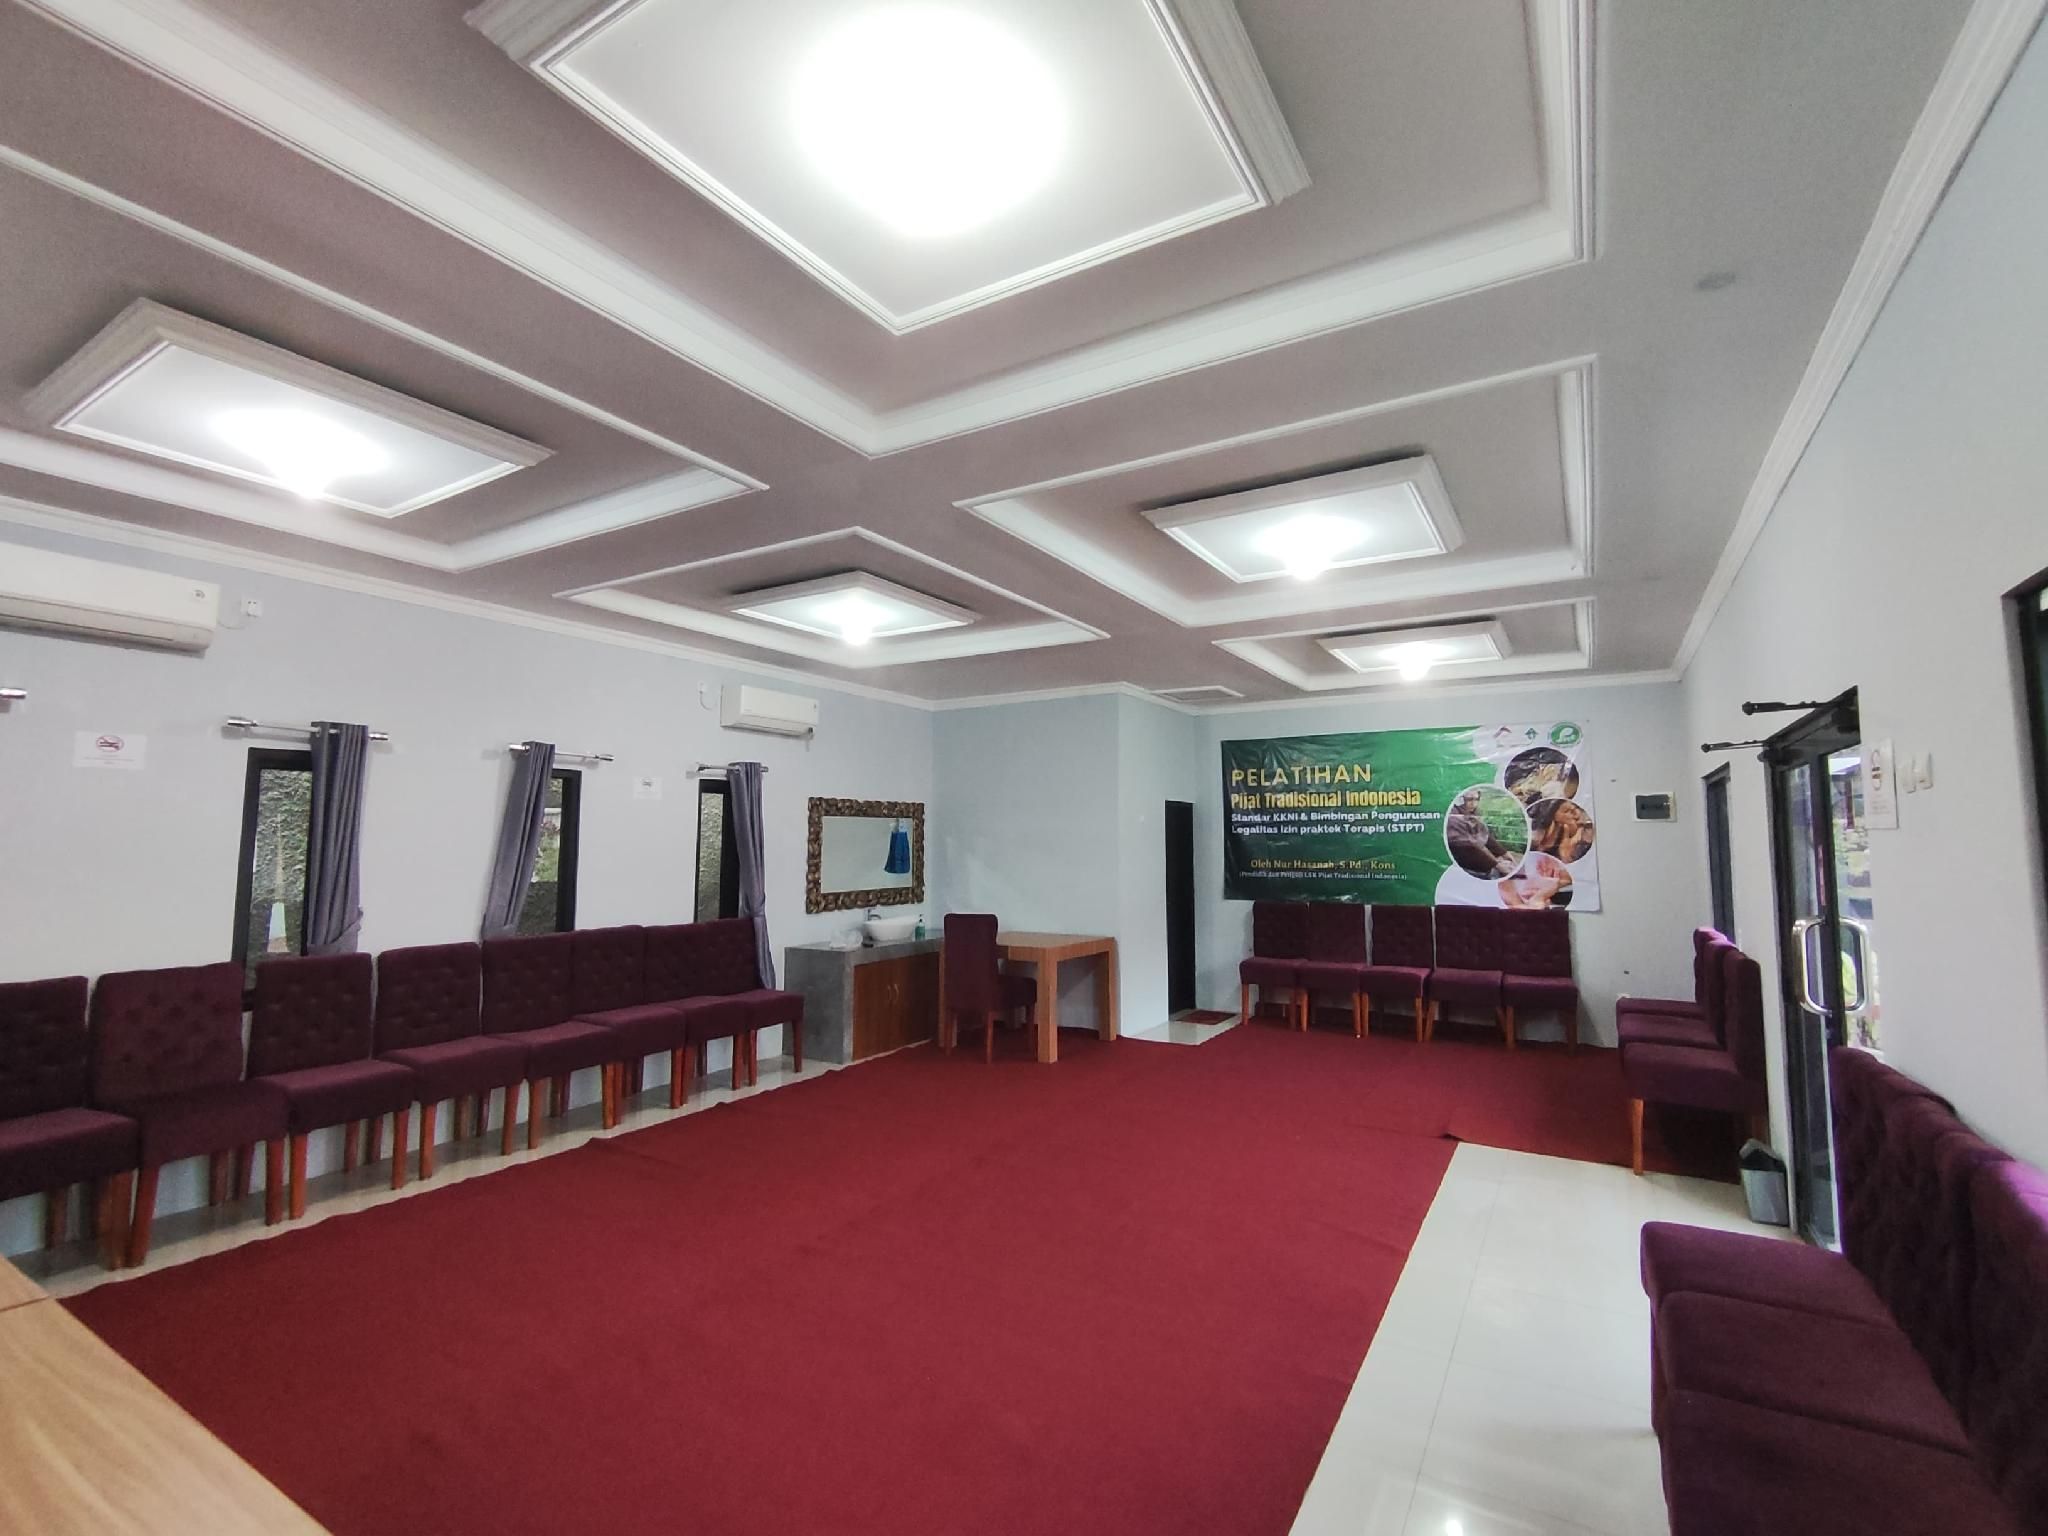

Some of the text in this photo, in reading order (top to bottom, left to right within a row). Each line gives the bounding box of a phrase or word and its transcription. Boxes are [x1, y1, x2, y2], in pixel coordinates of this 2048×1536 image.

[1231, 763, 1371, 787] PELATIHAN
[1231, 787, 1421, 810] Pijat Tradisional Indonesia
[1231, 810, 1440, 823] Standar KKNI & Bimbingan Pengurusan
[1231, 822, 1425, 836] Legalitas Izin praktek Terapis (STPT)
[1250, 859, 1272, 869] Oleh
[1274, 860, 1292, 868] Nur
